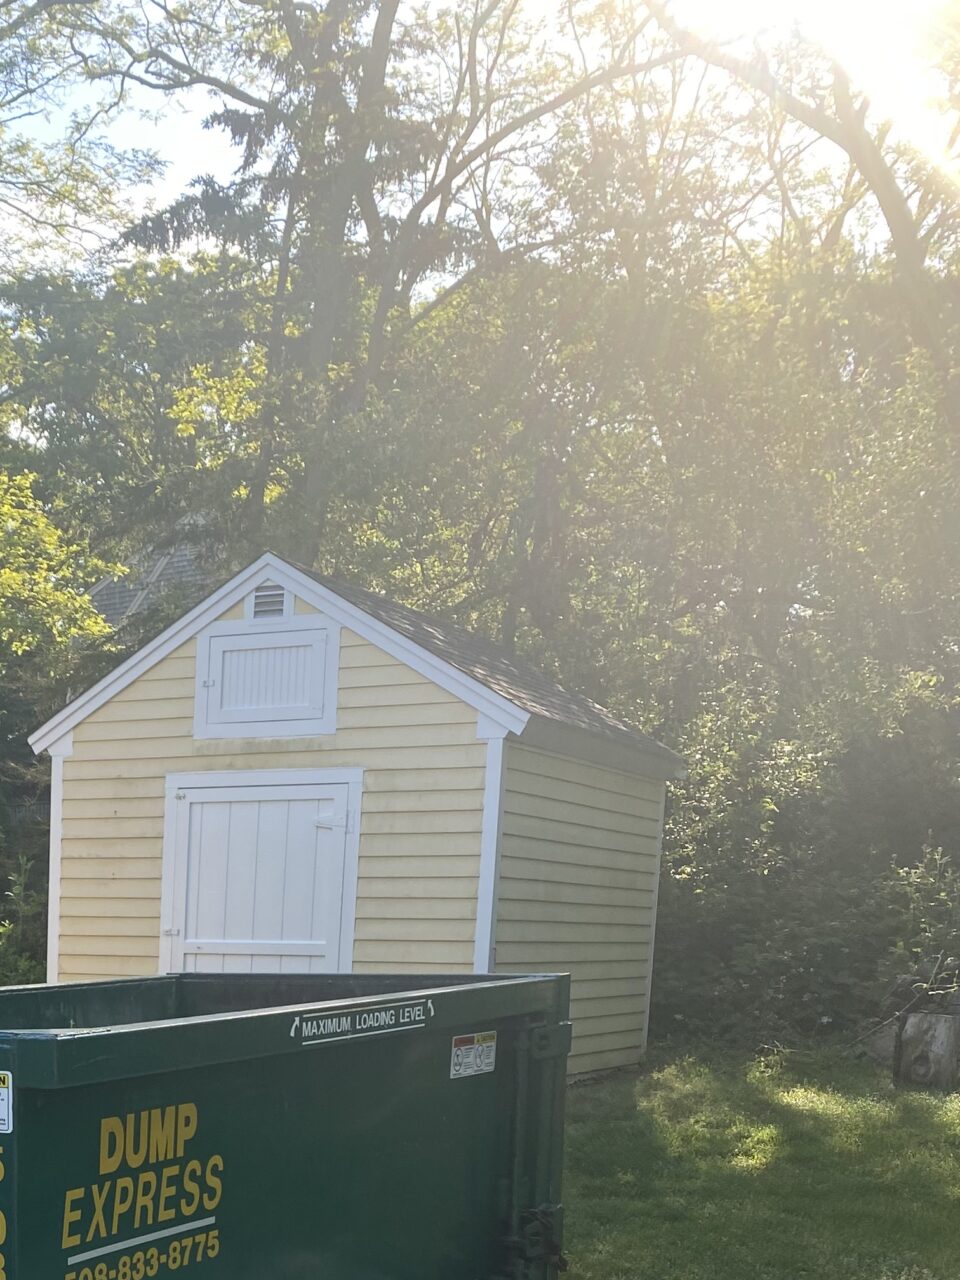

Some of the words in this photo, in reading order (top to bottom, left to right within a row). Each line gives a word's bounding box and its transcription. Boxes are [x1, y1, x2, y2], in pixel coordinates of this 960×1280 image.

[302, 1016, 352, 1037] MAXIMUM
[356, 1010, 395, 1029] LOADING
[400, 1006, 425, 1023] LEVEL
[99, 1103, 198, 1175] DUMP
[61, 1154, 224, 1249] EXPRESS
